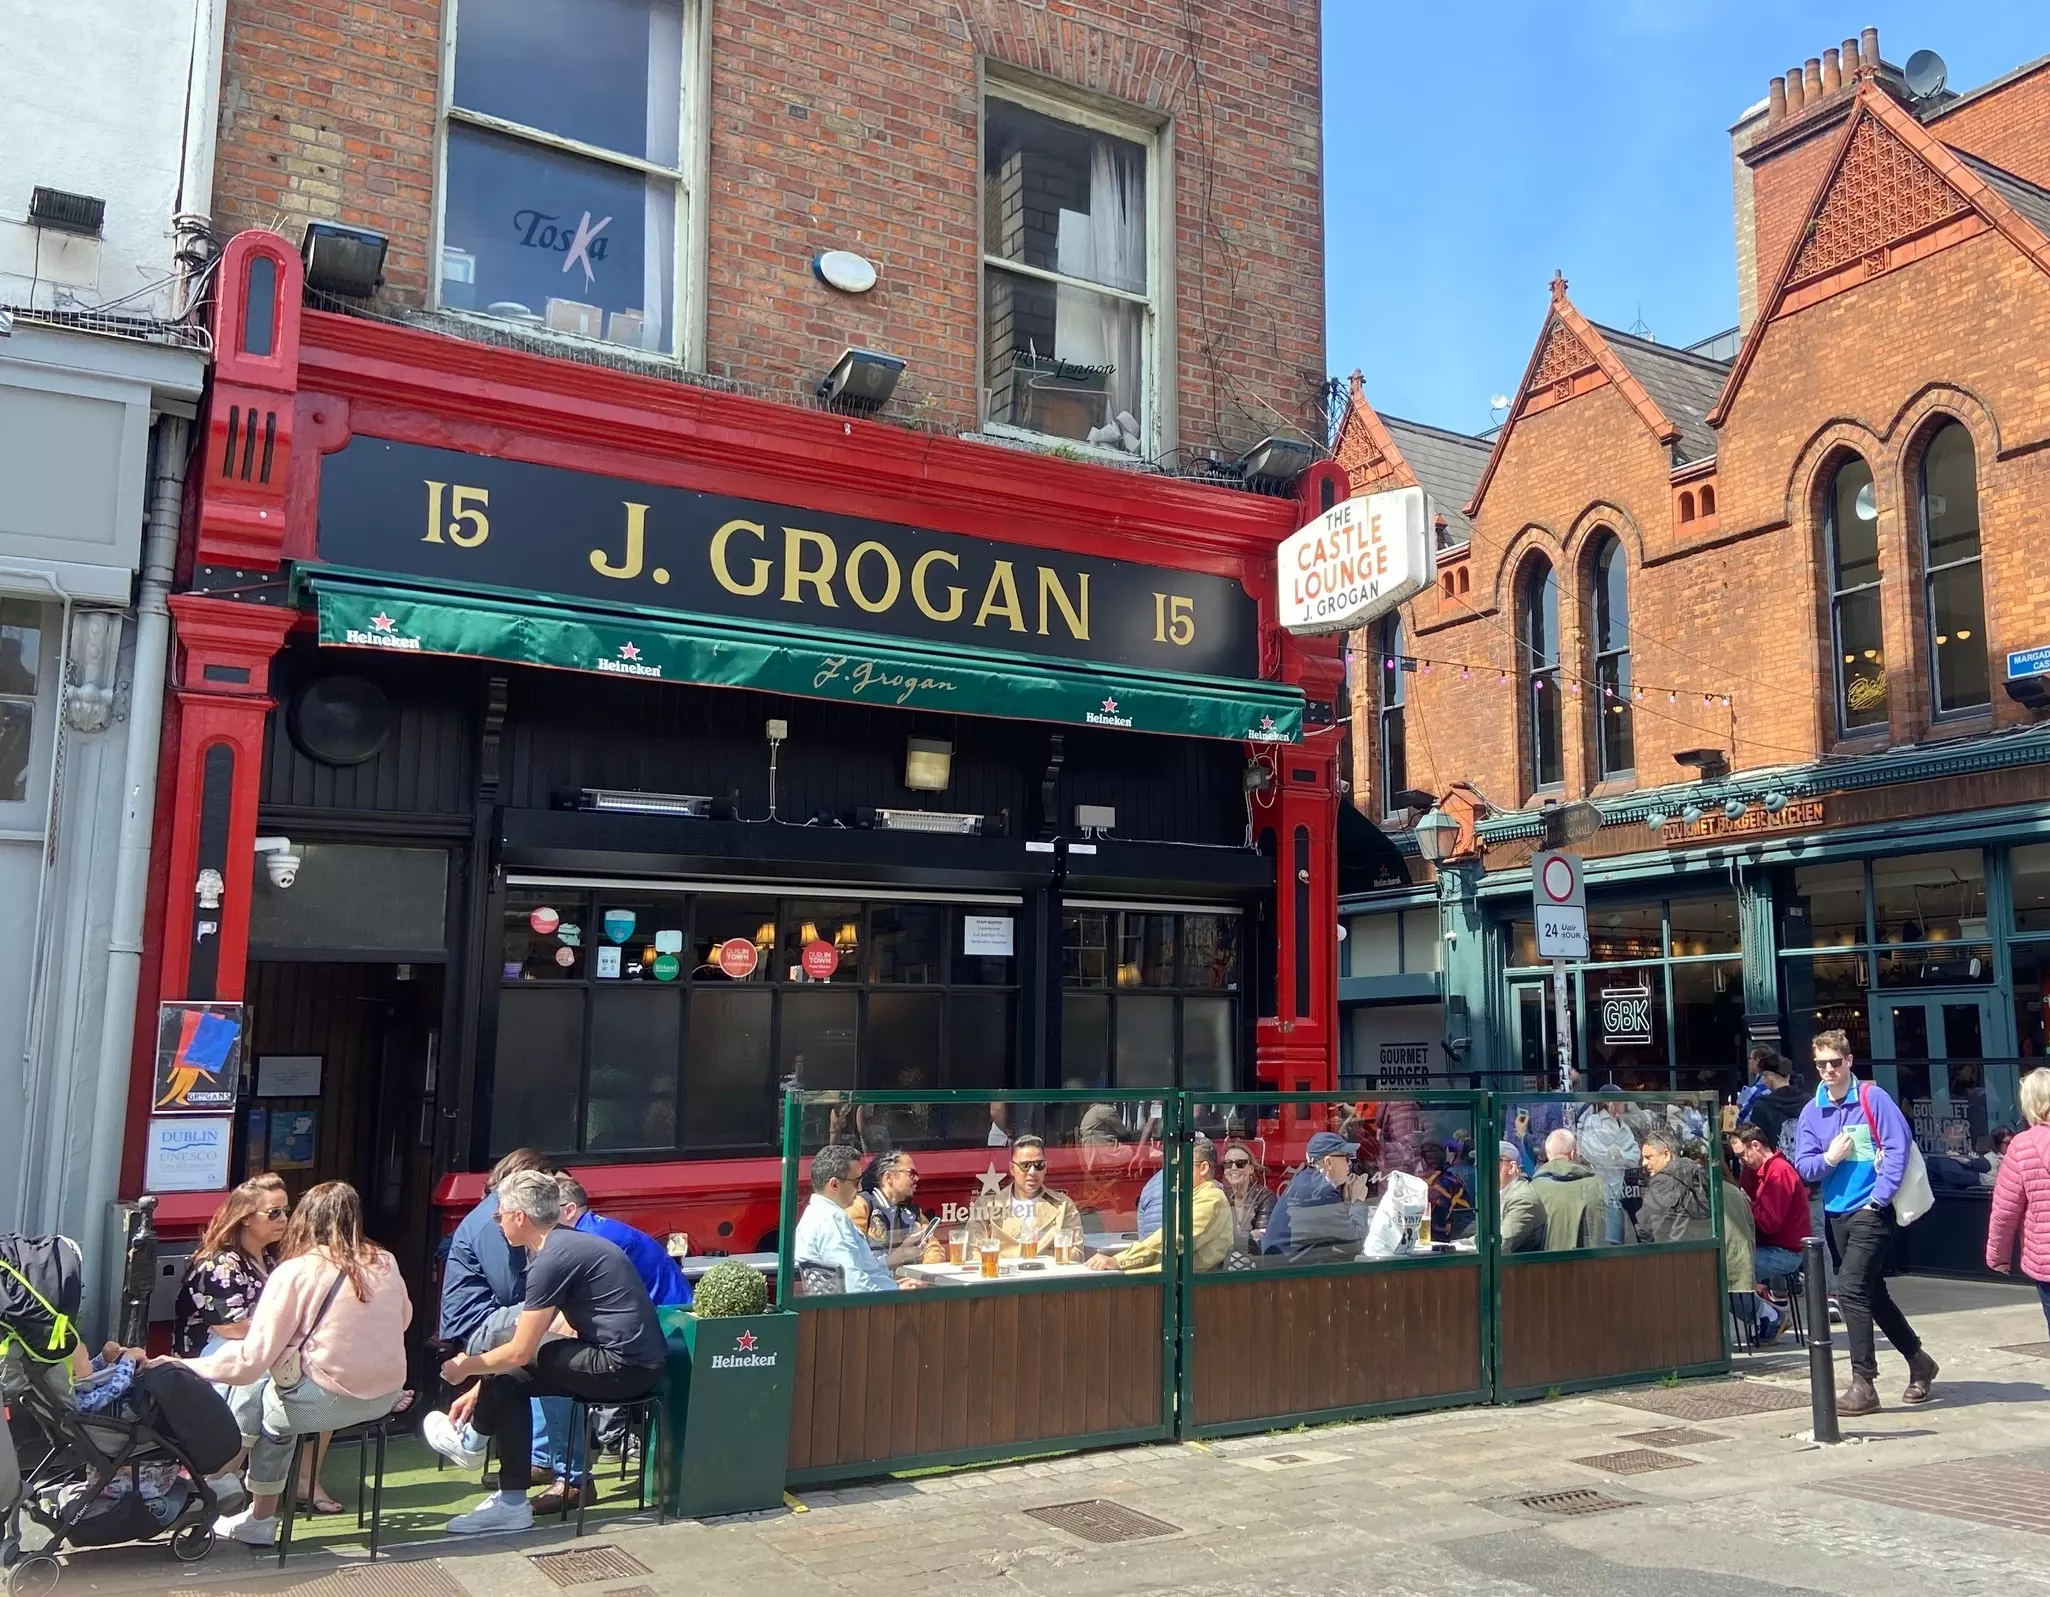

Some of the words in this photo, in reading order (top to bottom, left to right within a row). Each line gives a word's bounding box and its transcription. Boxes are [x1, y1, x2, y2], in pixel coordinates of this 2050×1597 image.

[1055, 358, 1117, 381] Lennon
[1325, 506, 1351, 531] THE
[1297, 513, 1382, 571] CASTLE
[421, 480, 490, 548] 15
[589, 500, 671, 585] J.
[709, 518, 1091, 641] GROGAN
[1152, 592, 1196, 646] 15
[1294, 544, 1388, 605] LOUNGE
[1303, 604, 1313, 621] J.
[1317, 580, 1379, 616] GROGAN
[346, 630, 421, 649] Heineken
[598, 657, 662, 677] Heineken
[2033, 660, 2050, 670] CAS
[852, 662, 958, 704] Grogan
[1086, 712, 1133, 727] Heineken
[1248, 728, 1290, 742] Heineken
[1662, 817, 1717, 841] GOURMET
[1545, 923, 1558, 938] 24
[1603, 1000, 1650, 1032] GBK
[1380, 1048, 1429, 1064] GOURMET
[1913, 1103, 1971, 1118] GOUMET
[162, 1131, 218, 1142] DUBLIN
[1914, 1118, 1972, 1137] BURGER
[160, 1151, 217, 1162] UNESCO
[941, 1200, 1036, 1223] Heineken
[711, 1352, 778, 1369] Heineken
